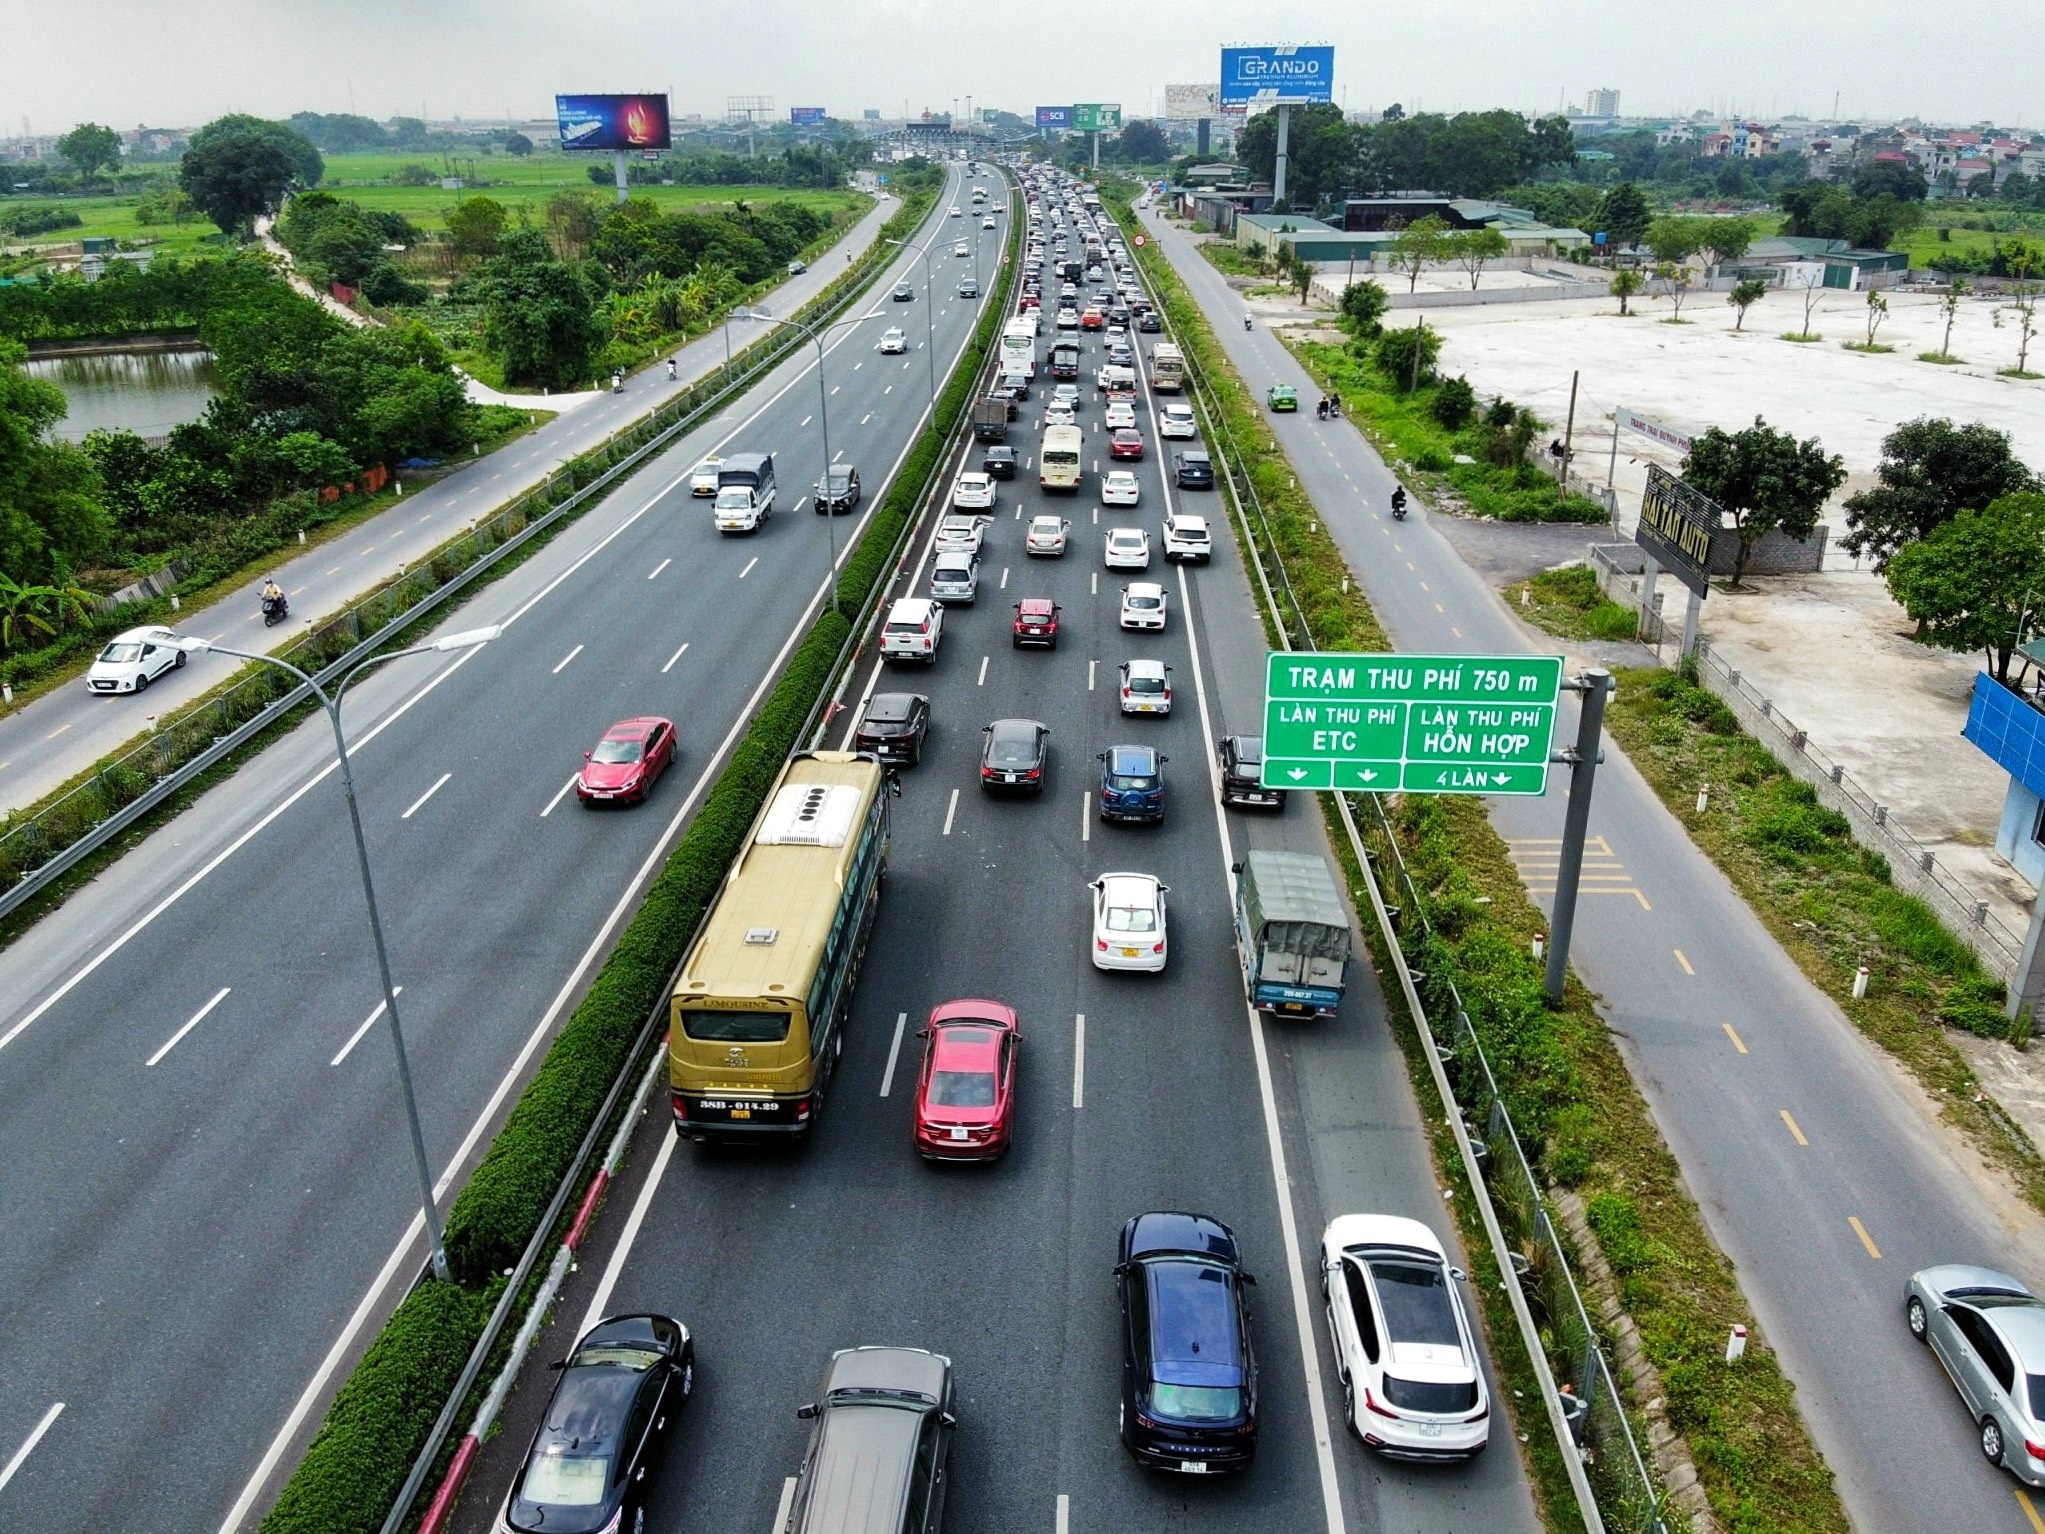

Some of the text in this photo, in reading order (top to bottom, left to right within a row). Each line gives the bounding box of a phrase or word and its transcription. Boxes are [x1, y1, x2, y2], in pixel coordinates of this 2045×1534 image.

[1245, 60, 1319, 74] GRANDO
[1049, 111, 1065, 120] SCB
[1679, 520, 1710, 566] AUTO
[1288, 663, 1538, 695] TRẠM THU PHÍ 750 m
[1280, 702, 1398, 725] LÀN THU PHÍ
[1420, 705, 1543, 728] LÀN THU PHÍ
[1312, 730, 1357, 751] ETC
[1481, 733, 1530, 760] HỢP
[1436, 767, 1488, 788] 4 LÀN
[703, 1000, 769, 1009] LIMOUSINE
